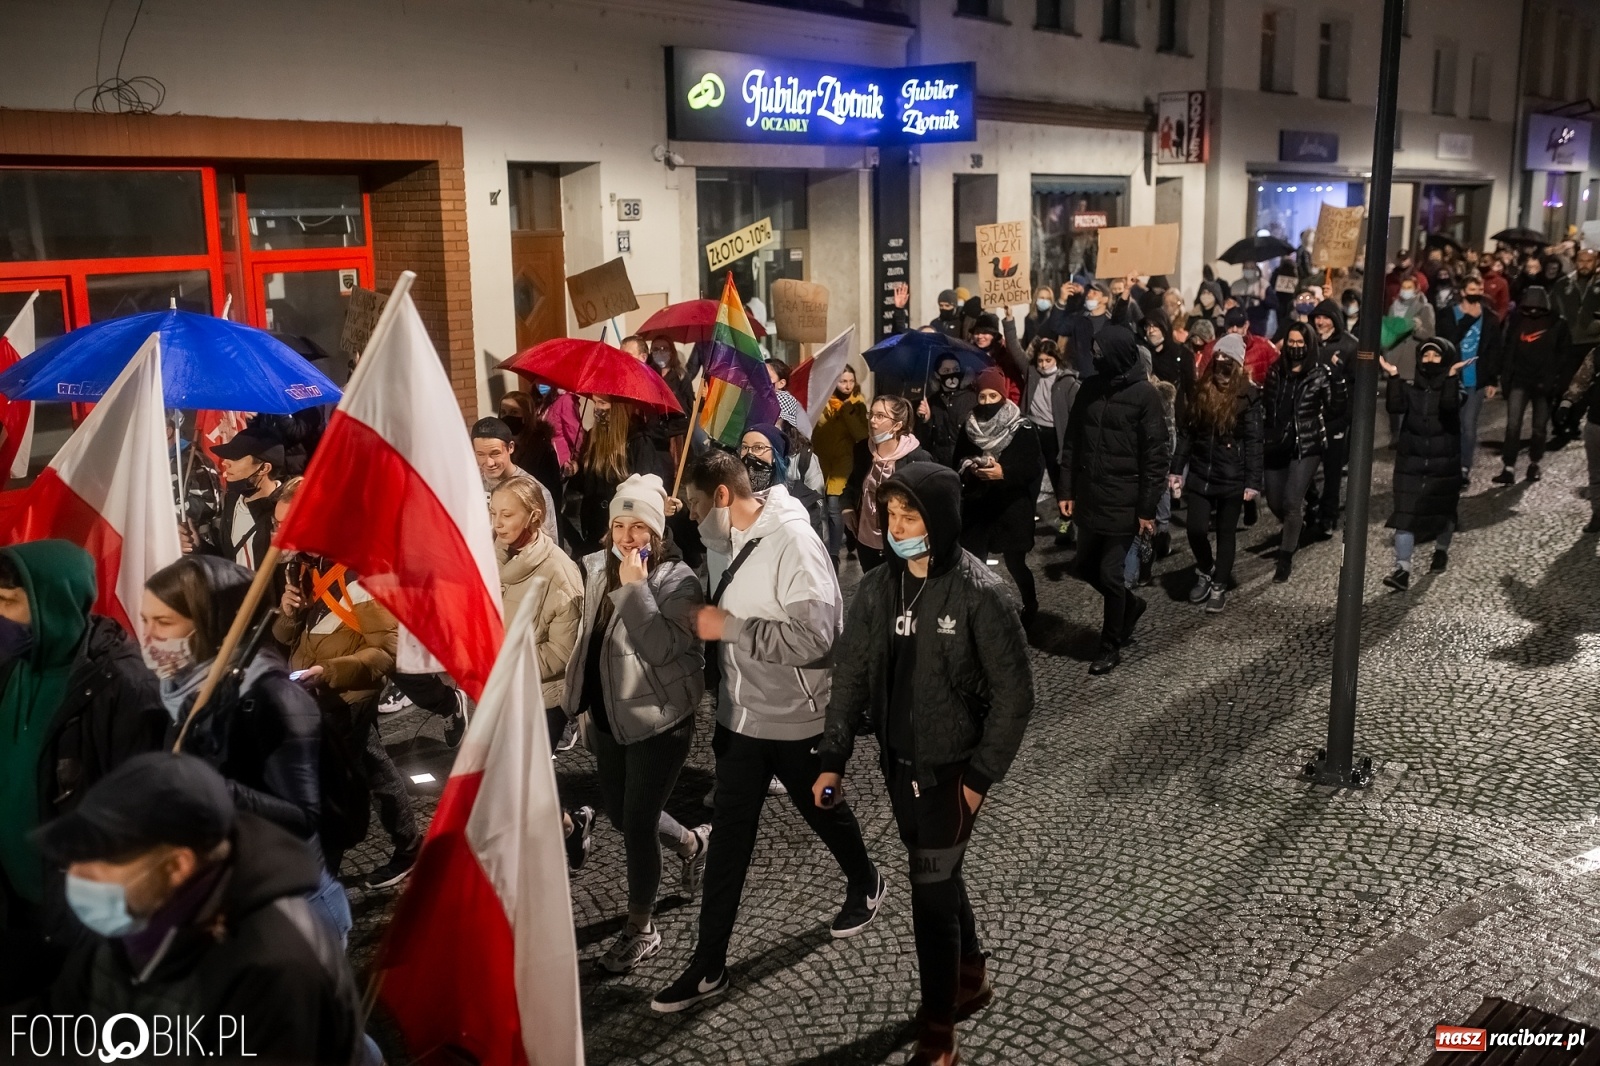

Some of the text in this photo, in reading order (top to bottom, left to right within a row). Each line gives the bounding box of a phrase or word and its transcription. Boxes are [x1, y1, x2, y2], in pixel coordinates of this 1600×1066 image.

[742, 69, 885, 127] Jubiler Złotnik
[901, 78, 959, 110] Jubiler
[901, 109, 960, 135] Złotnik
[624, 202, 640, 216] 36
[979, 222, 1022, 242] STARE
[709, 235, 744, 266] ZŁOTO
[980, 238, 1021, 257] KACZKI
